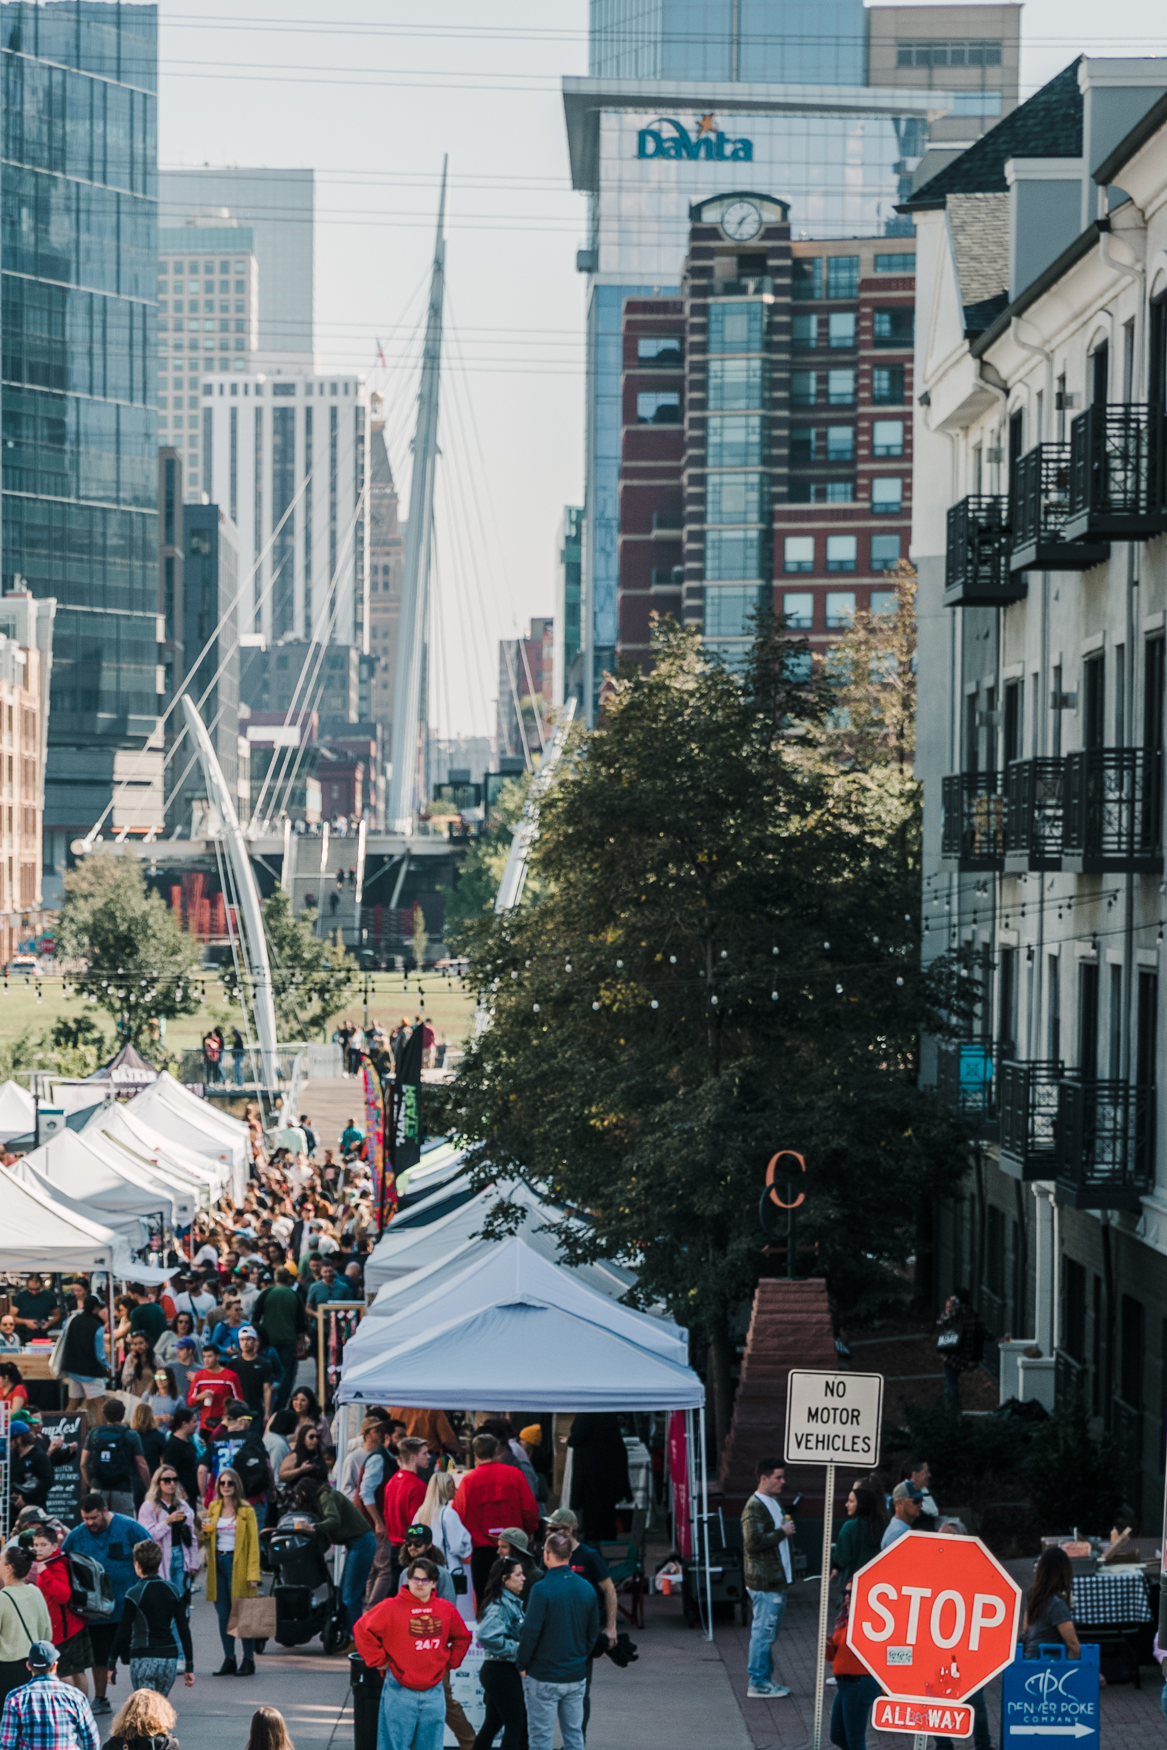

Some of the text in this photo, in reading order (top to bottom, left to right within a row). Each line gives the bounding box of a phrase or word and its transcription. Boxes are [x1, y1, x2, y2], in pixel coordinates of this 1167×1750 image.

[638, 118, 753, 161] DaVita
[824, 1380, 846, 1398] NO
[807, 1406, 860, 1426] MOTOR
[41, 1417, 81, 1436] mples!
[795, 1433, 871, 1453] VEHICLES
[862, 1583, 1006, 1651] STOP
[415, 1639, 441, 1651] 24/7
[881, 1705, 915, 1726] ALL
[928, 1709, 965, 1730] WAY
[1060, 1702, 1095, 1715] POKE
